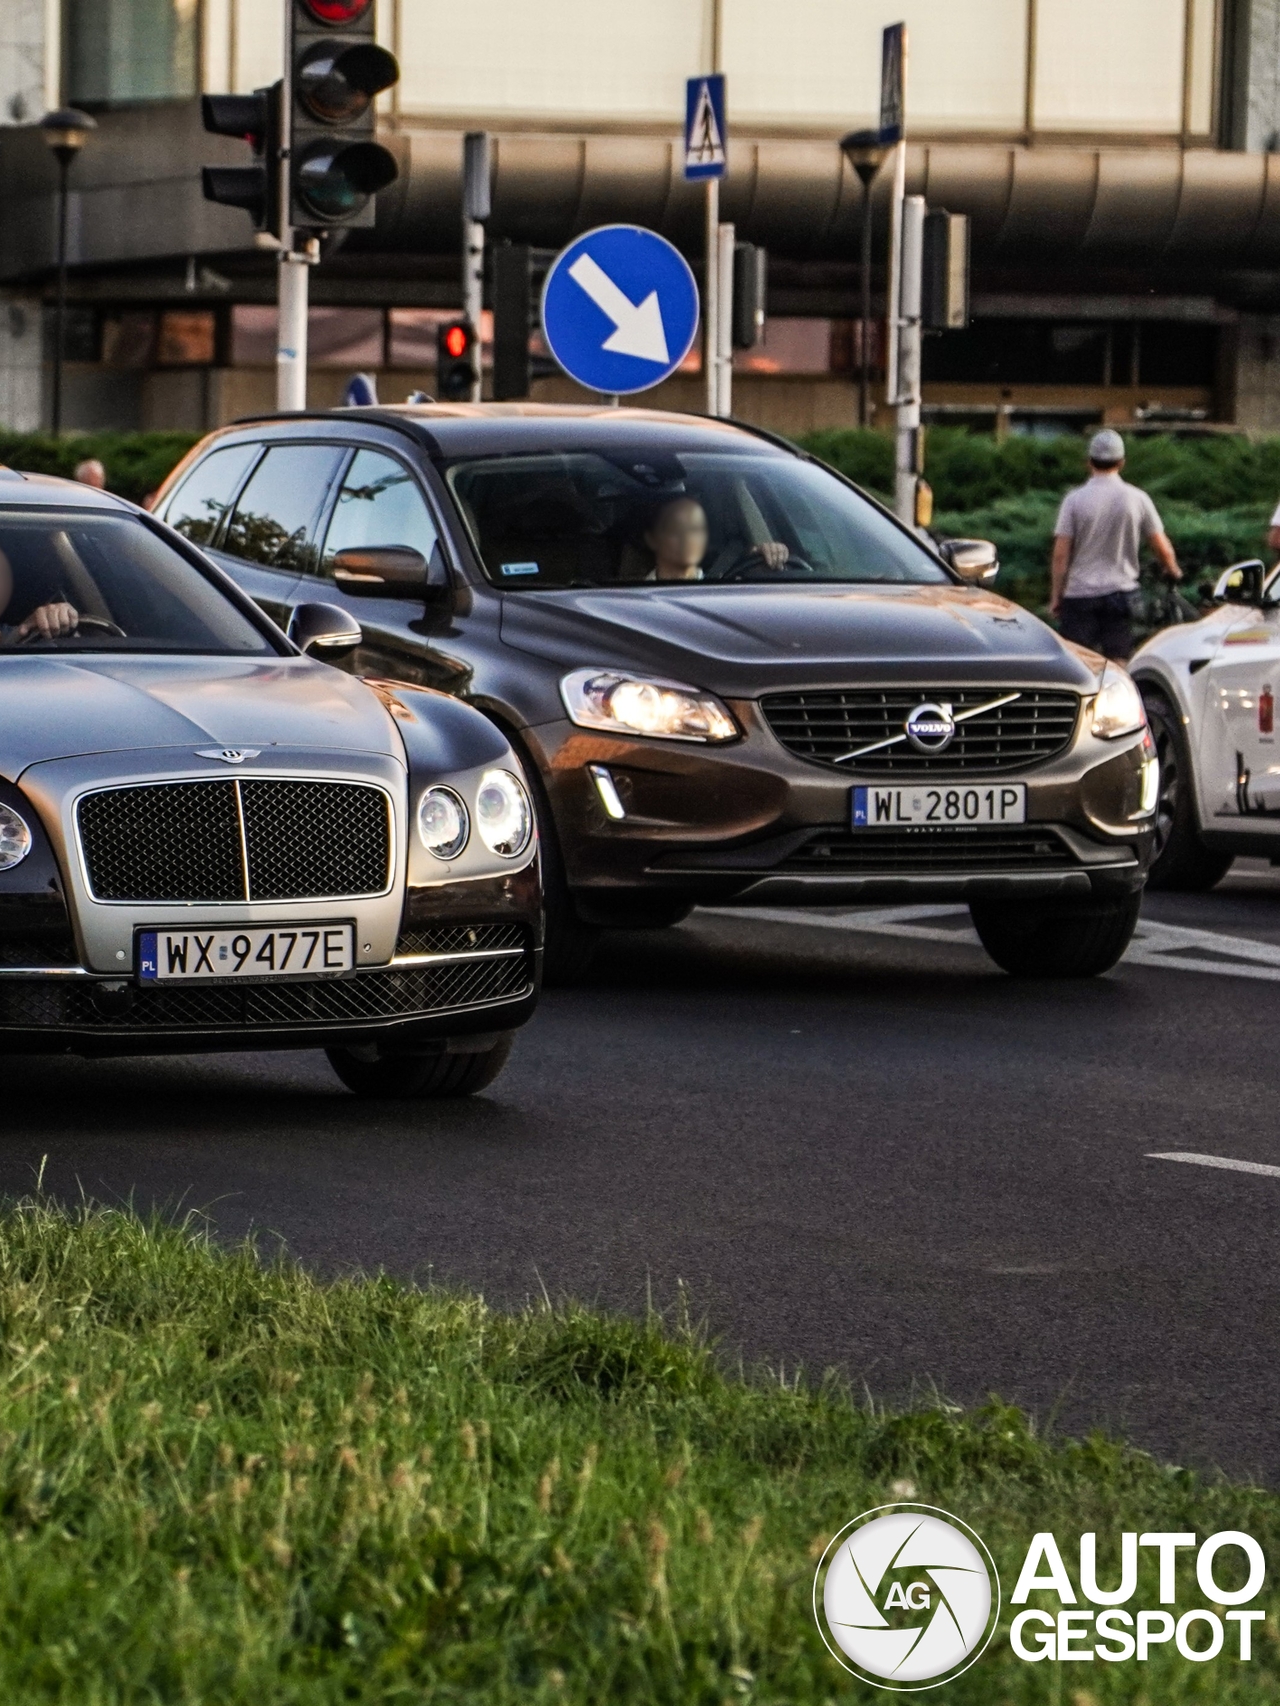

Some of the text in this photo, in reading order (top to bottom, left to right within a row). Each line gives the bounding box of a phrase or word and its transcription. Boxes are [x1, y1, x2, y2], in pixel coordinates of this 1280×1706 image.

[911, 724, 951, 733] VOLVO
[875, 789, 1018, 821] WL 2801P
[166, 930, 344, 974] WX 9477E
[142, 961, 156, 971] PL
